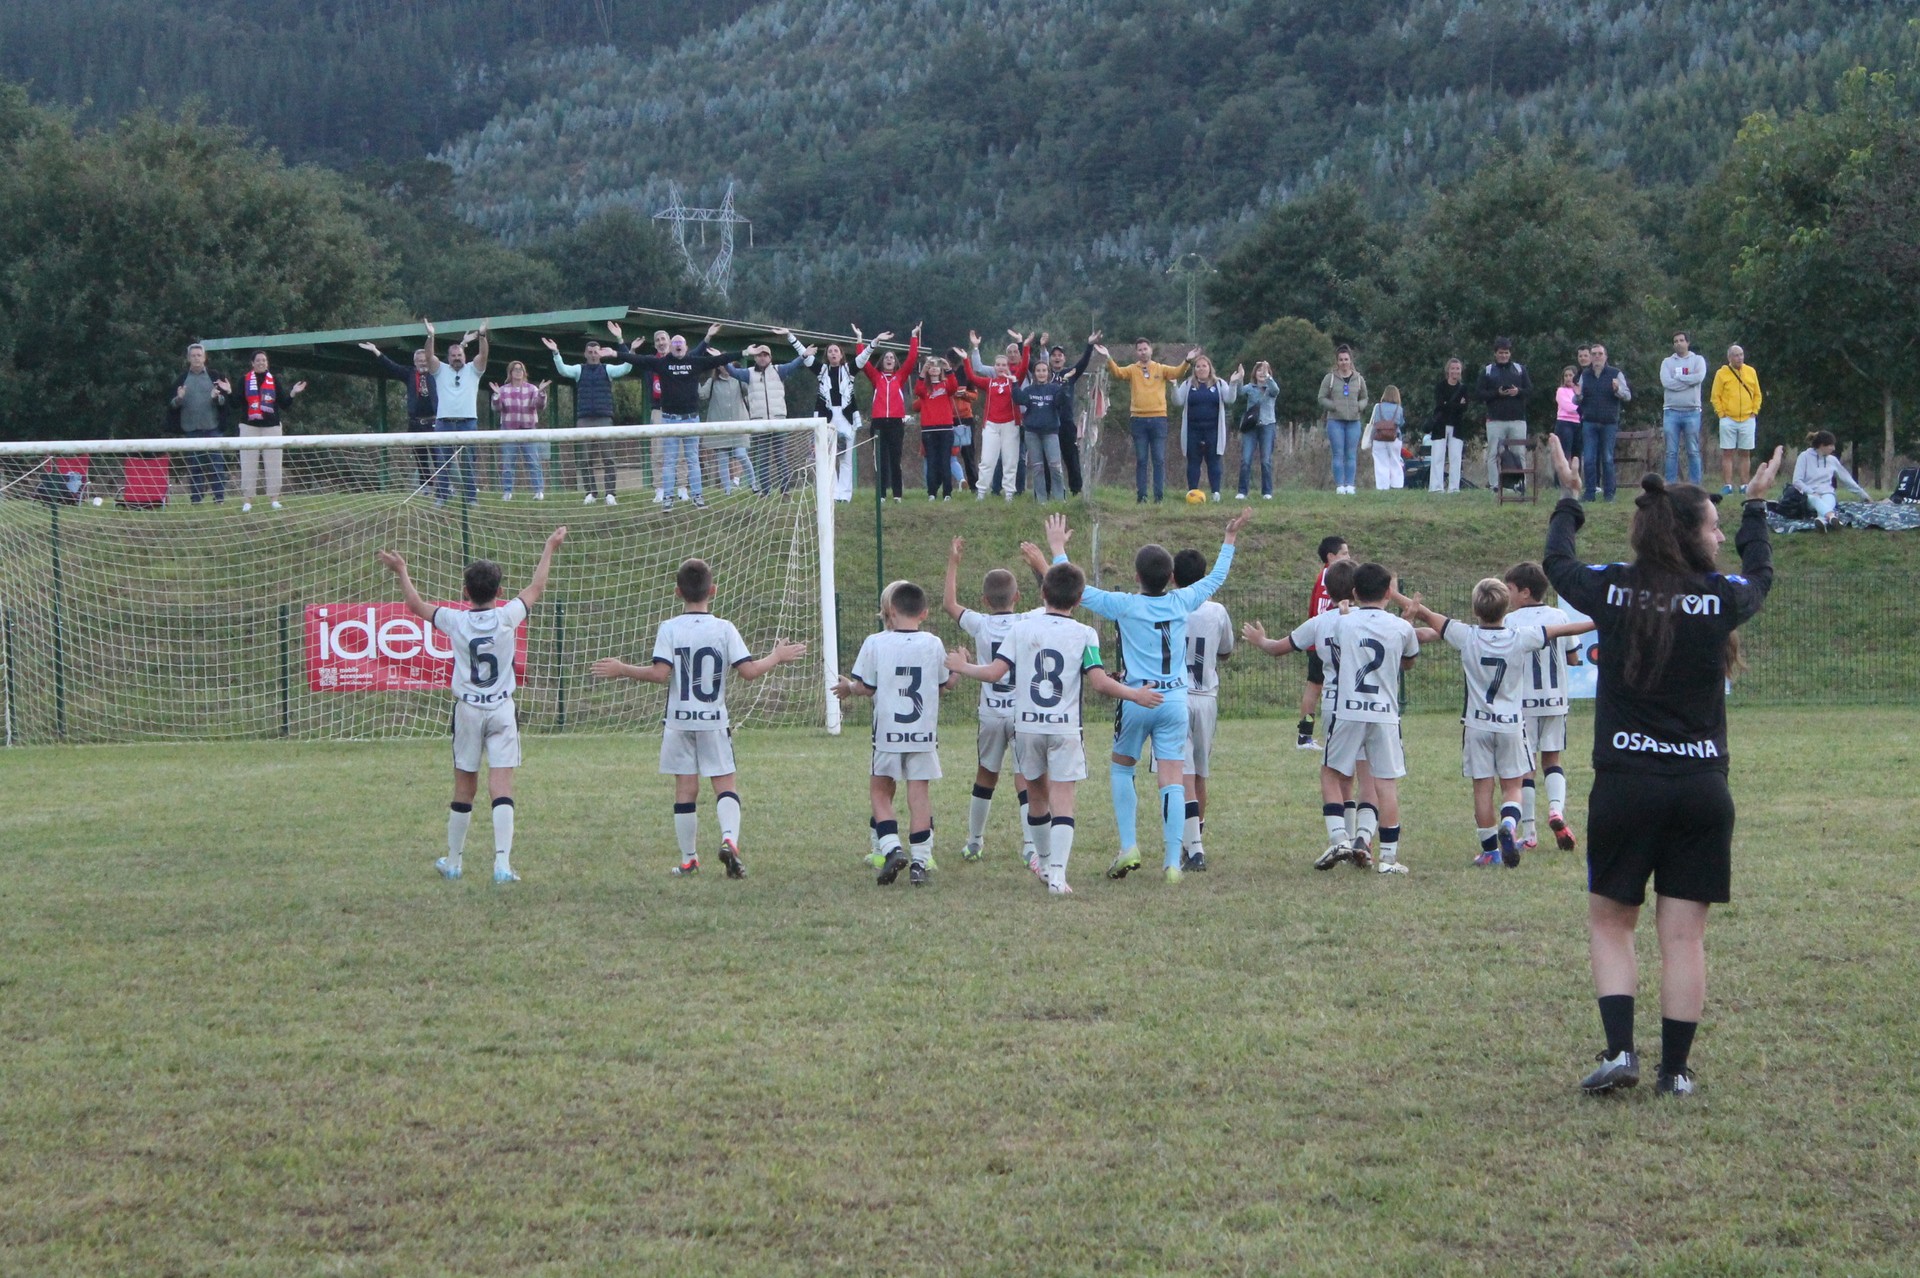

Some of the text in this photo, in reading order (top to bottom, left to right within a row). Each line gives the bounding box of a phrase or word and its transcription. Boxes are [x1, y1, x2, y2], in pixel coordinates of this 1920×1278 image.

[319, 607, 454, 660] ideu
[1154, 620, 1171, 675] 1
[468, 636, 499, 688] 6
[674, 646, 723, 703] 10
[1354, 637, 1385, 694] 2
[1532, 638, 1558, 690] 11
[1030, 648, 1064, 708] 8
[1142, 677, 1184, 689] DIGI
[1480, 656, 1508, 705] 7
[463, 690, 508, 704] DIGI
[894, 666, 923, 724] 3
[986, 698, 1016, 709] DIG
[1345, 699, 1391, 713] DIGI
[1522, 696, 1564, 709] DIGI
[674, 710, 721, 721] DIGI
[1021, 711, 1069, 723] DIGI
[1474, 709, 1519, 724] DIGI
[886, 731, 933, 743] DIGI
[1612, 731, 1718, 759] OSASUNA
